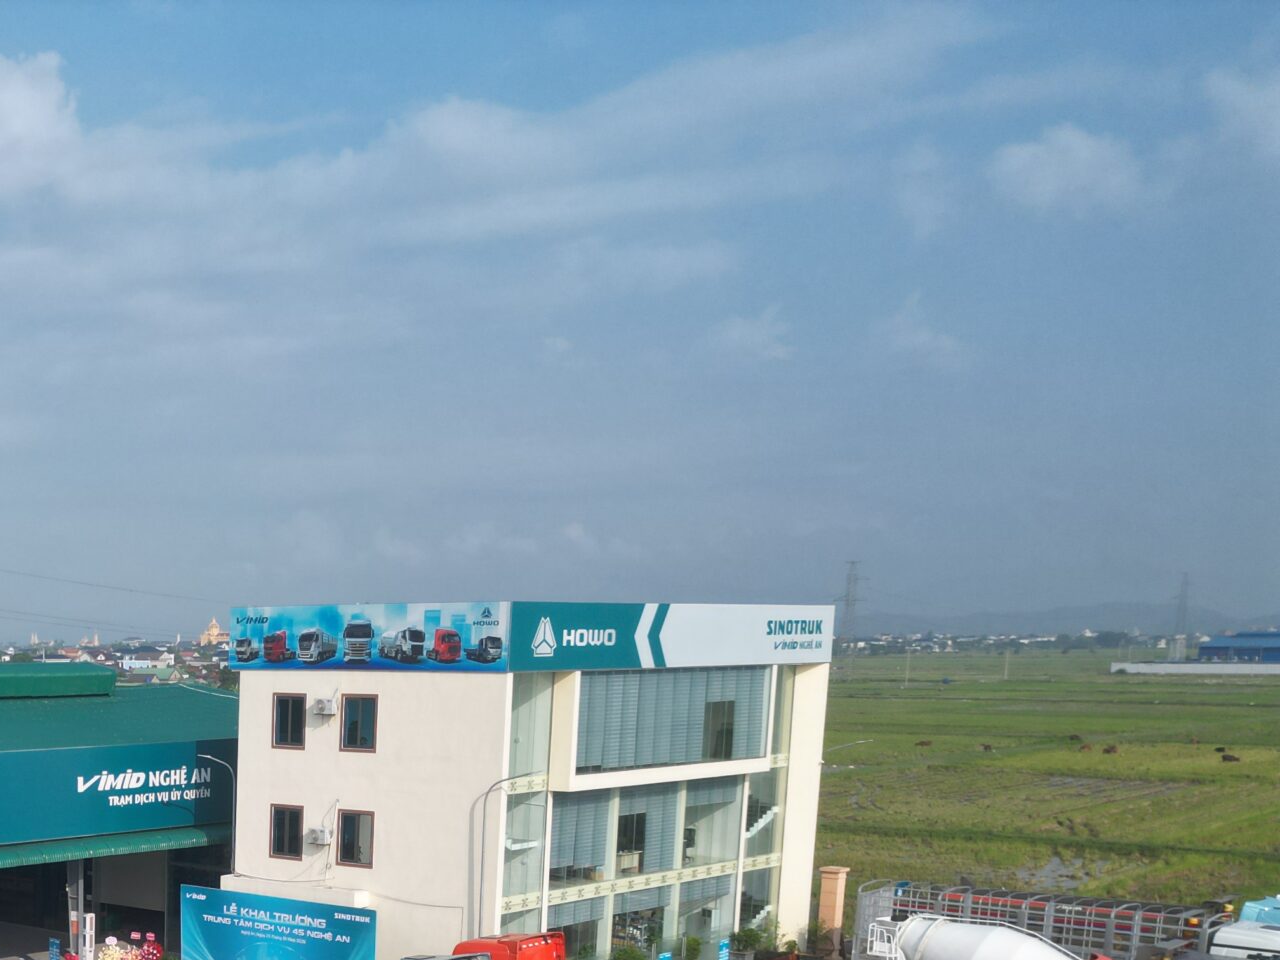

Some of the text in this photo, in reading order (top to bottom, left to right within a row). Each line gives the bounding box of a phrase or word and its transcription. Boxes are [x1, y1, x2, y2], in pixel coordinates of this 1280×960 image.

[472, 619, 499, 627] HOWO
[766, 619, 823, 636] SINOTRUK
[561, 628, 617, 647] HOWO
[148, 765, 188, 788] NGHỆ
[191, 767, 211, 784] AN
[108, 794, 133, 807] TRẠM
[134, 793, 156, 806] DỊCH
[157, 791, 169, 803] VỤ
[240, 907, 270, 921] KHAI
[202, 914, 232, 925] TRUNG
[233, 917, 253, 928] TÂM
[254, 921, 275, 931] DỊCH
[276, 925, 290, 935] VỤ
[306, 929, 333, 942] NGHỆ
[335, 934, 351, 944] AN
